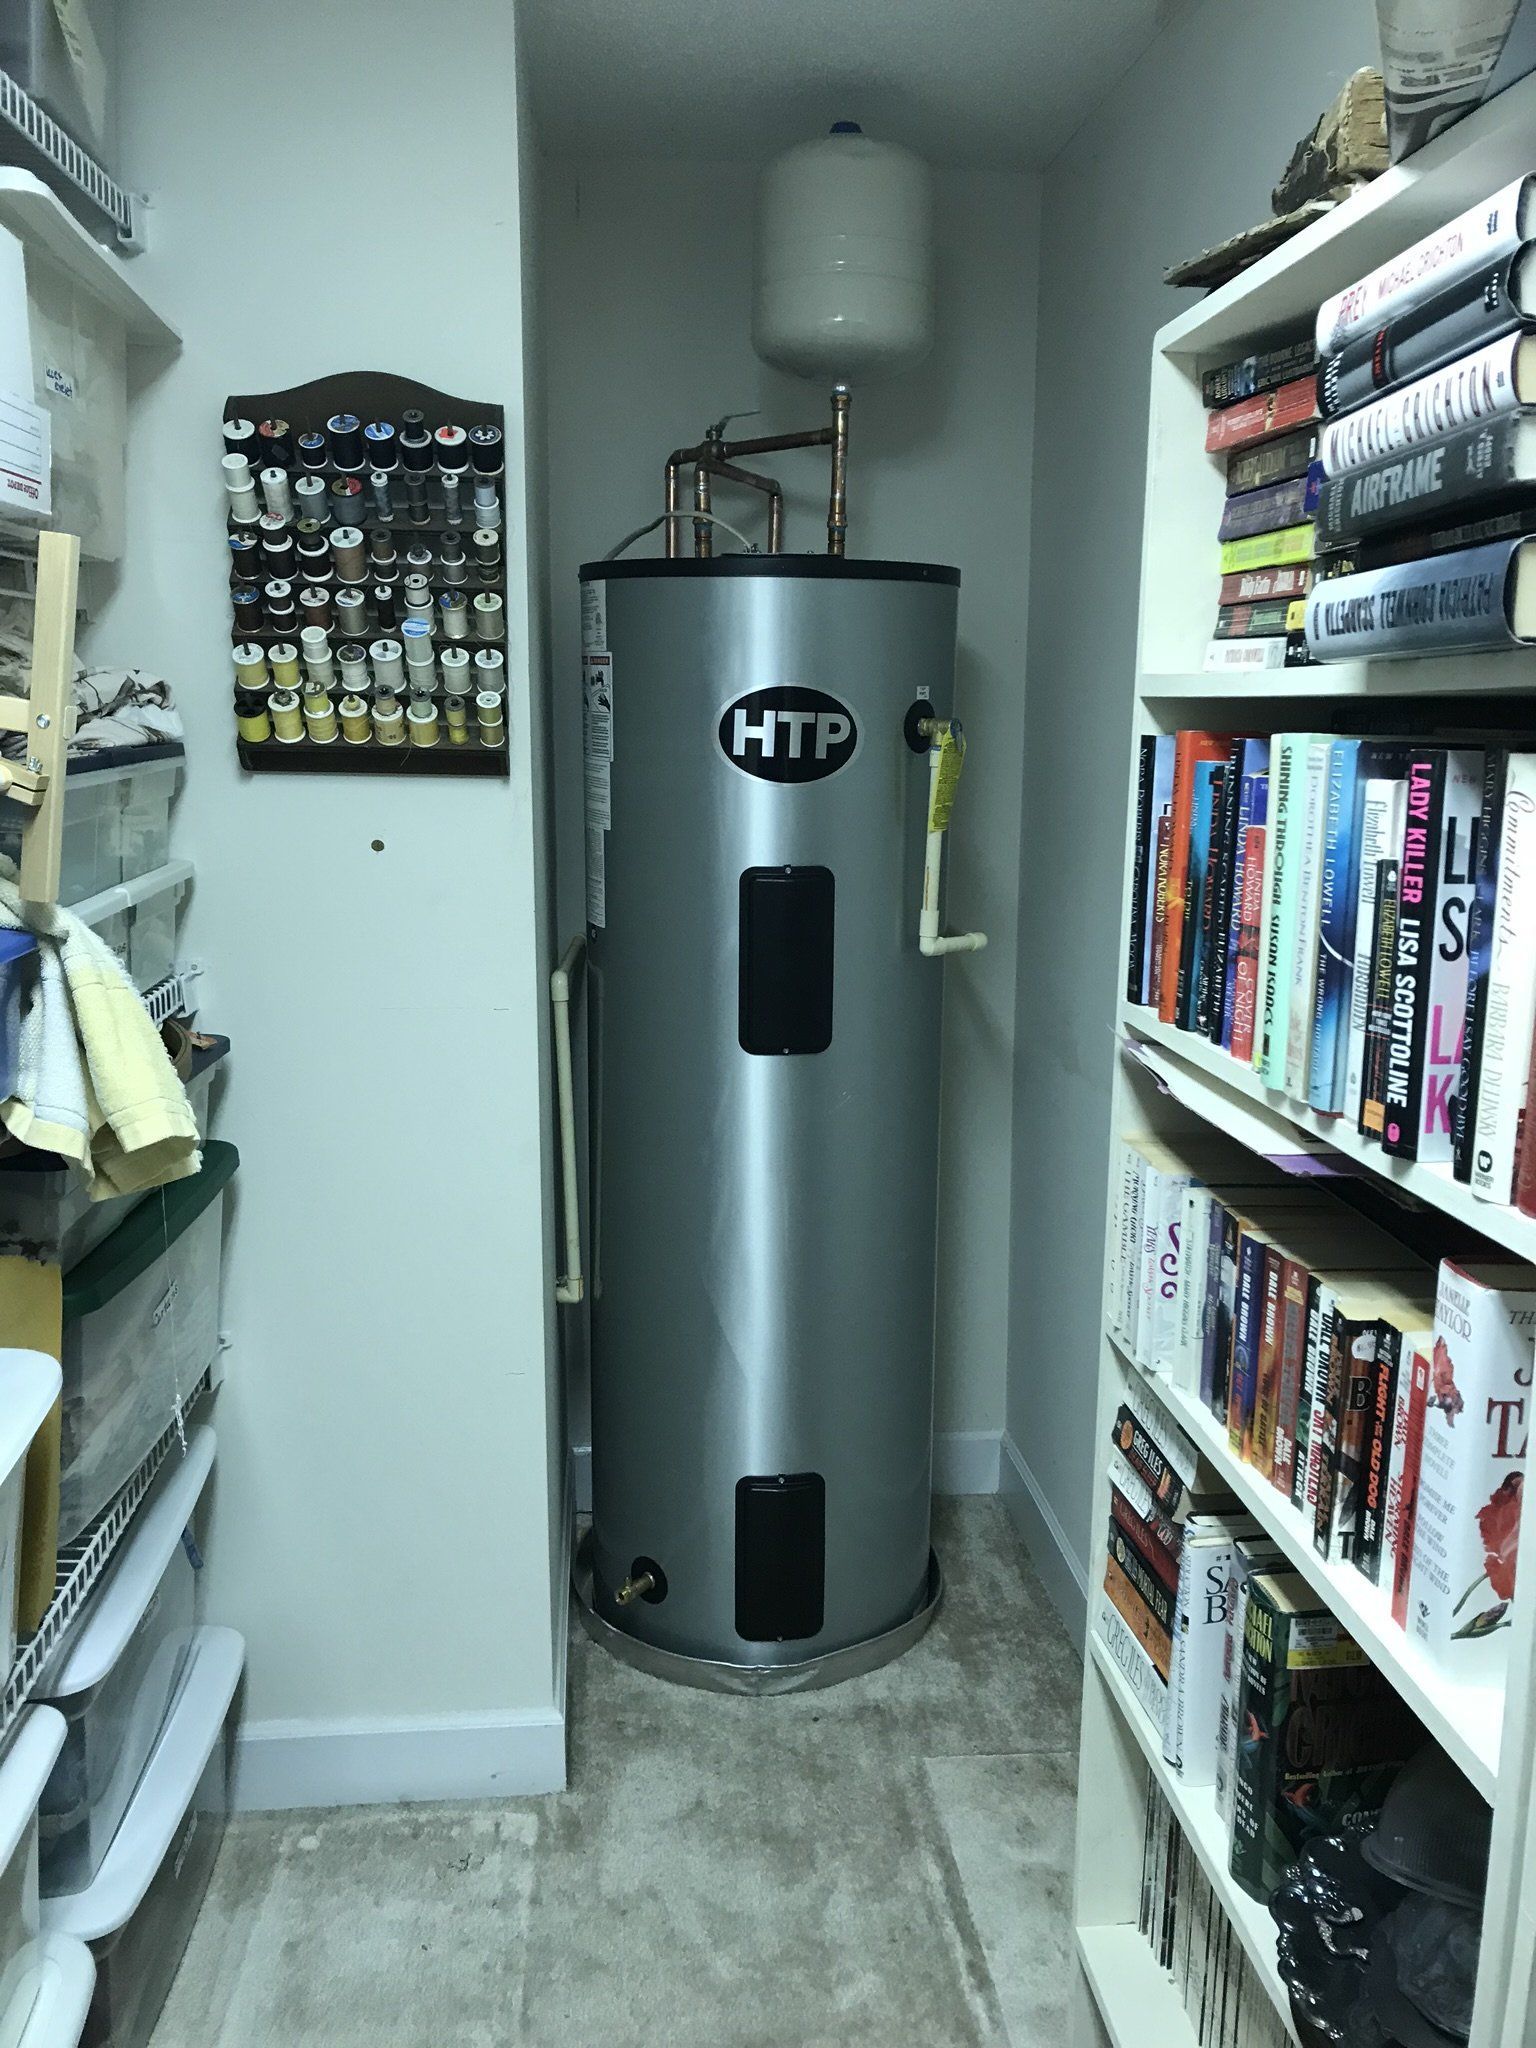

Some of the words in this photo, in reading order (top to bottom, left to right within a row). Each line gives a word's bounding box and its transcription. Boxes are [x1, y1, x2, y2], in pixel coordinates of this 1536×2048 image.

[1330, 407, 1395, 473] MICHAEL
[1403, 360, 1496, 444] CRICHTON
[24, 485, 39, 500] Office
[1350, 446, 1446, 518] AIRFRAME
[1325, 594, 1375, 636] SCARPETTA
[733, 708, 851, 759] HTP
[1277, 745, 1293, 813] SHINING
[1326, 749, 1345, 851] ELIZABETH
[1409, 762, 1433, 820] LADY
[1235, 806, 1250, 855] LINDA
[1363, 799, 1388, 858] Elizabeth
[1271, 819, 1288, 906] THROUGH
[1402, 827, 1427, 904] KILLER
[1499, 788, 1536, 945] Commitments
[1155, 878, 1167, 923] ROBERTS
[1230, 861, 1245, 932] HOWARD
[1241, 857, 1256, 921] HOWARD
[1252, 870, 1263, 911] LINDA
[1320, 858, 1336, 925] LOWELL
[1380, 899, 1397, 950] ELIZABETH
[1396, 917, 1421, 966] LISA
[1314, 976, 1326, 1020] WRONG
[1376, 951, 1394, 999] LOWELL
[1386, 973, 1416, 1108] SCOTTOLINE
[1484, 982, 1511, 1061] BARBARA
[1478, 1068, 1503, 1141] DELINSKY
[1241, 1273, 1252, 1300] DALE
[1267, 1271, 1279, 1299] DALE
[1237, 1302, 1250, 1342] BROWN
[1264, 1301, 1277, 1346] BROWN
[1307, 1308, 1319, 1342] DALE
[1319, 1312, 1332, 1347] DALE
[1303, 1344, 1316, 1395] BROWN
[1314, 1349, 1329, 1403] BROWN
[1375, 1362, 1389, 1422] FLIGHT
[1132, 1430, 1150, 1459] GREG
[1149, 1446, 1163, 1476] ILES
[1273, 1425, 1285, 1466] BROWN
[1282, 1437, 1293, 1465] DALE
[1371, 1438, 1384, 1471] OLD
[1294, 1449, 1306, 1499] ATTACK
[1366, 1471, 1380, 1509] DOG
[1363, 1509, 1372, 1542] BROWN
